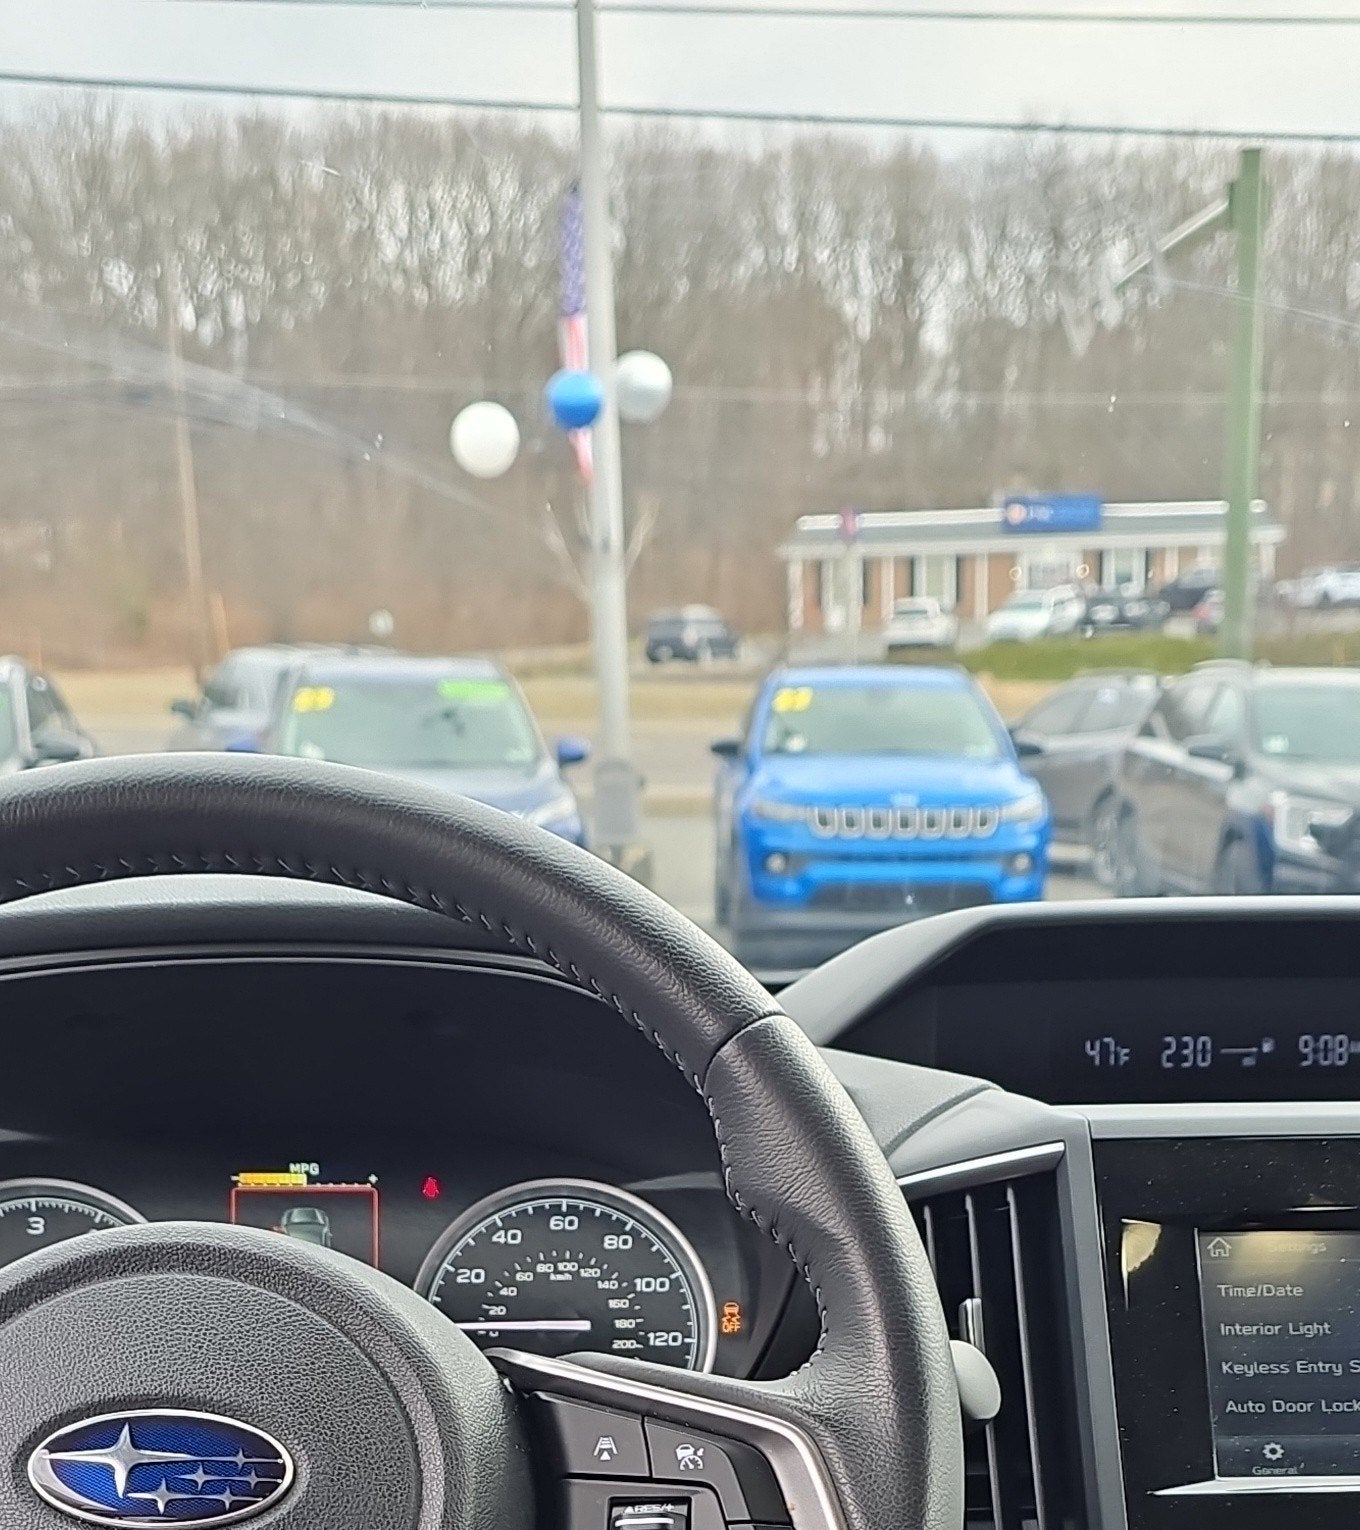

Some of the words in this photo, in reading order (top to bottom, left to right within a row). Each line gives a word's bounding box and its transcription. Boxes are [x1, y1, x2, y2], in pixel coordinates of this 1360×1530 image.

[1160, 1036, 1213, 1068] 230
[289, 1162, 320, 1176] MPG
[25, 1216, 46, 1236] 3
[549, 1215, 579, 1231] 60
[491, 1229, 522, 1245] 40
[603, 1234, 633, 1251] 80
[556, 1261, 579, 1272] 100
[579, 1268, 601, 1278] 120
[455, 1268, 485, 1284] 20
[515, 1271, 534, 1282] 60
[498, 1286, 518, 1297] 40
[596, 1280, 619, 1290] 140
[633, 1277, 671, 1293] 100
[1217, 1283, 1305, 1299] Time/Date
[488, 1305, 507, 1316] 20
[1219, 1322, 1283, 1337] Interior
[1288, 1321, 1333, 1339] Light
[611, 1339, 637, 1349] 200
[646, 1331, 683, 1347] 120
[1221, 1360, 1290, 1378] Keyless
[1297, 1360, 1343, 1377] Entry
[1225, 1399, 1266, 1414] Auto
[1272, 1398, 1313, 1414] Door
[1252, 1465, 1298, 1476] General
